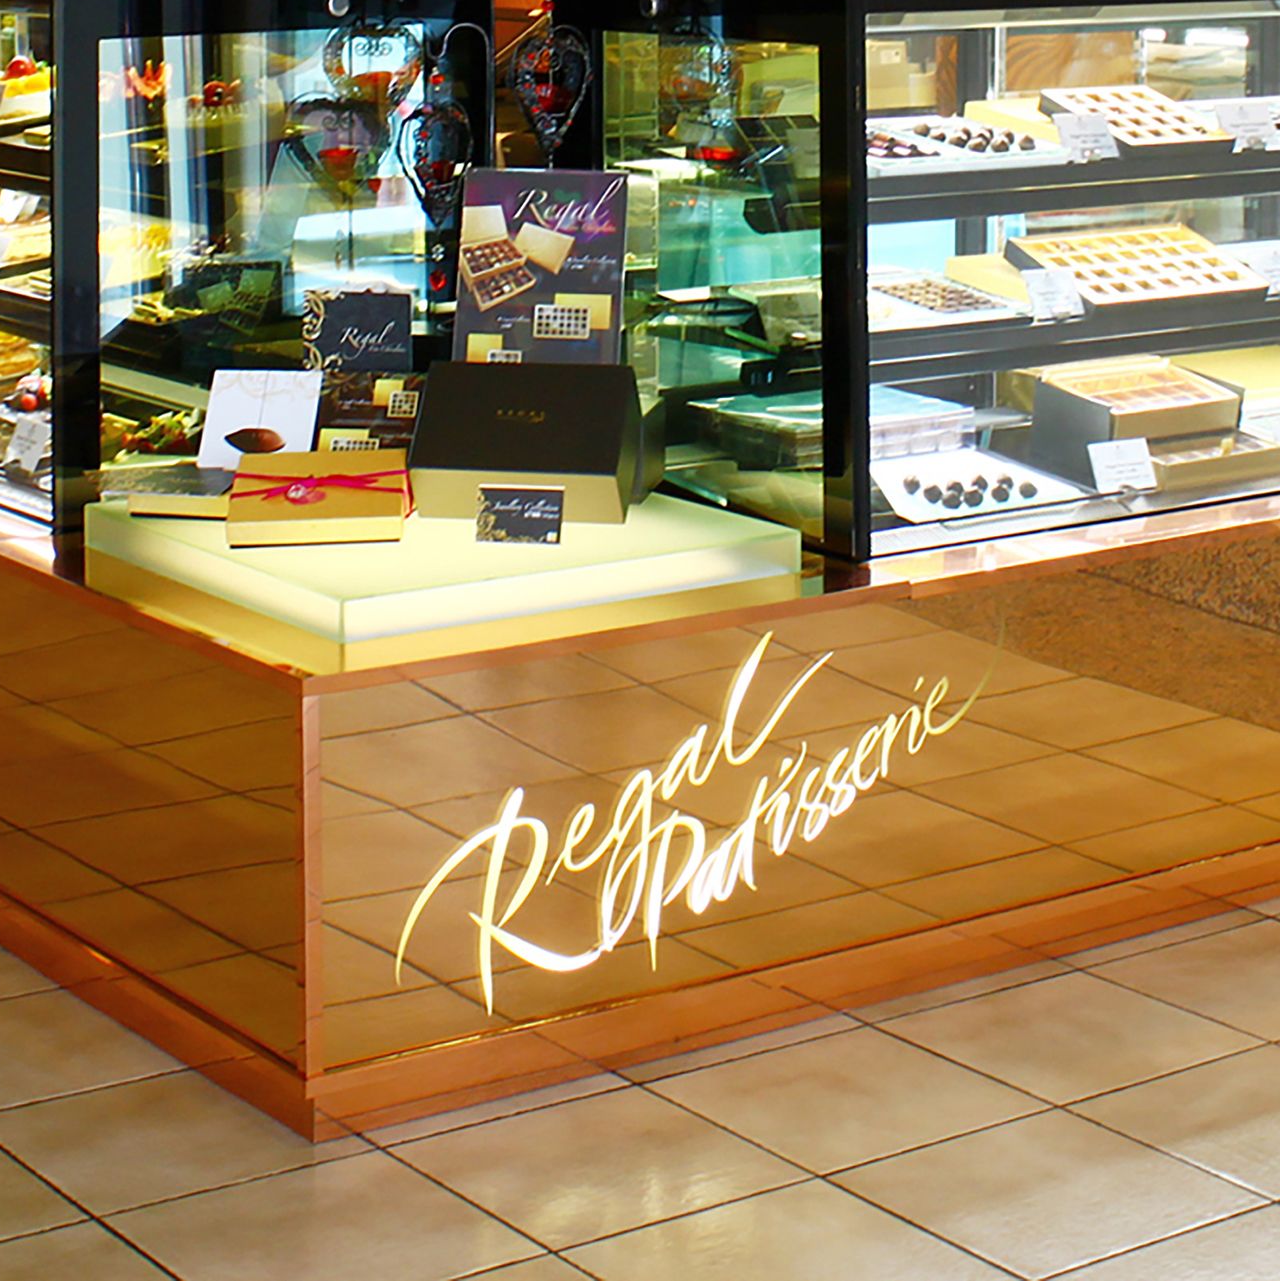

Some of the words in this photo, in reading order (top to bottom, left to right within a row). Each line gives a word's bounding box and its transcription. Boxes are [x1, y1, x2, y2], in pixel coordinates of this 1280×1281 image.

[512, 176, 625, 232] Regal
[339, 320, 396, 361] Regal
[395, 630, 834, 1017] Regal
[600, 617, 1006, 972] Patisserie
